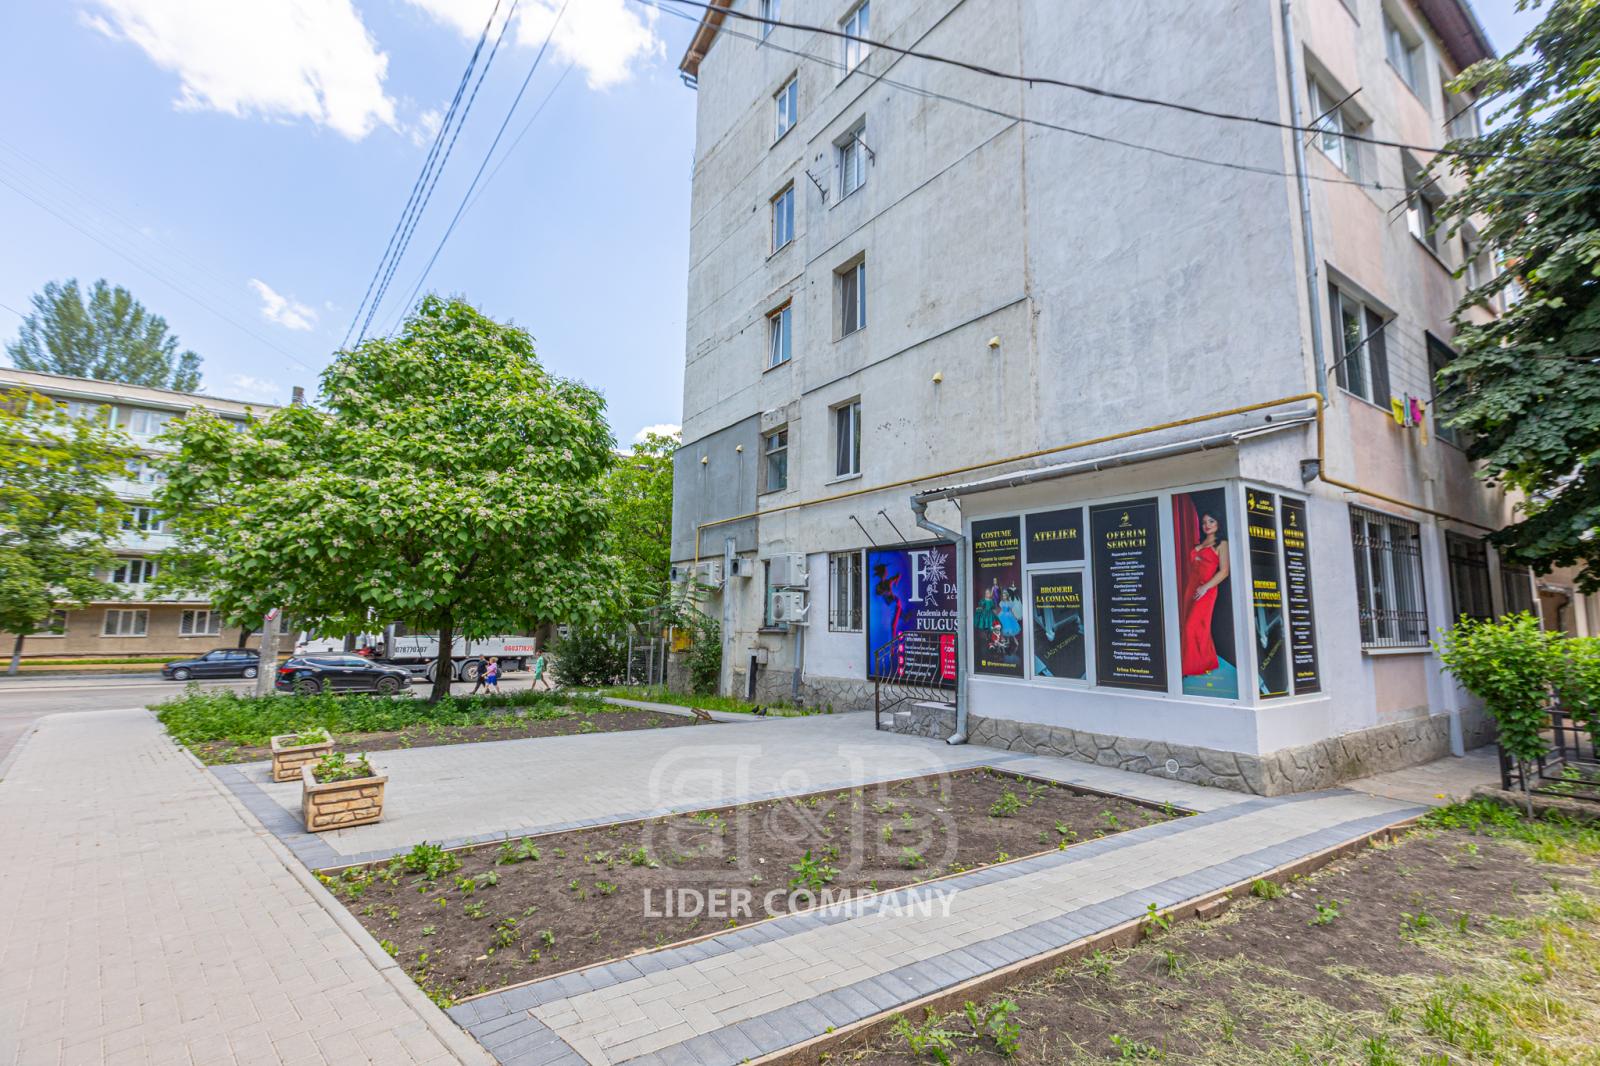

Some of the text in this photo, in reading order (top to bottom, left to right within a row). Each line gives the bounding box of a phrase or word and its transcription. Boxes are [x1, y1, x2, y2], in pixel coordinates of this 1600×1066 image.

[981, 530, 1011, 539] COSTUME
[1033, 529, 1077, 541] ATELIER
[1106, 529, 1146, 539] OFERIM
[1106, 539, 1146, 549] SERVICII
[1045, 594, 1080, 602] COMANDĂ
